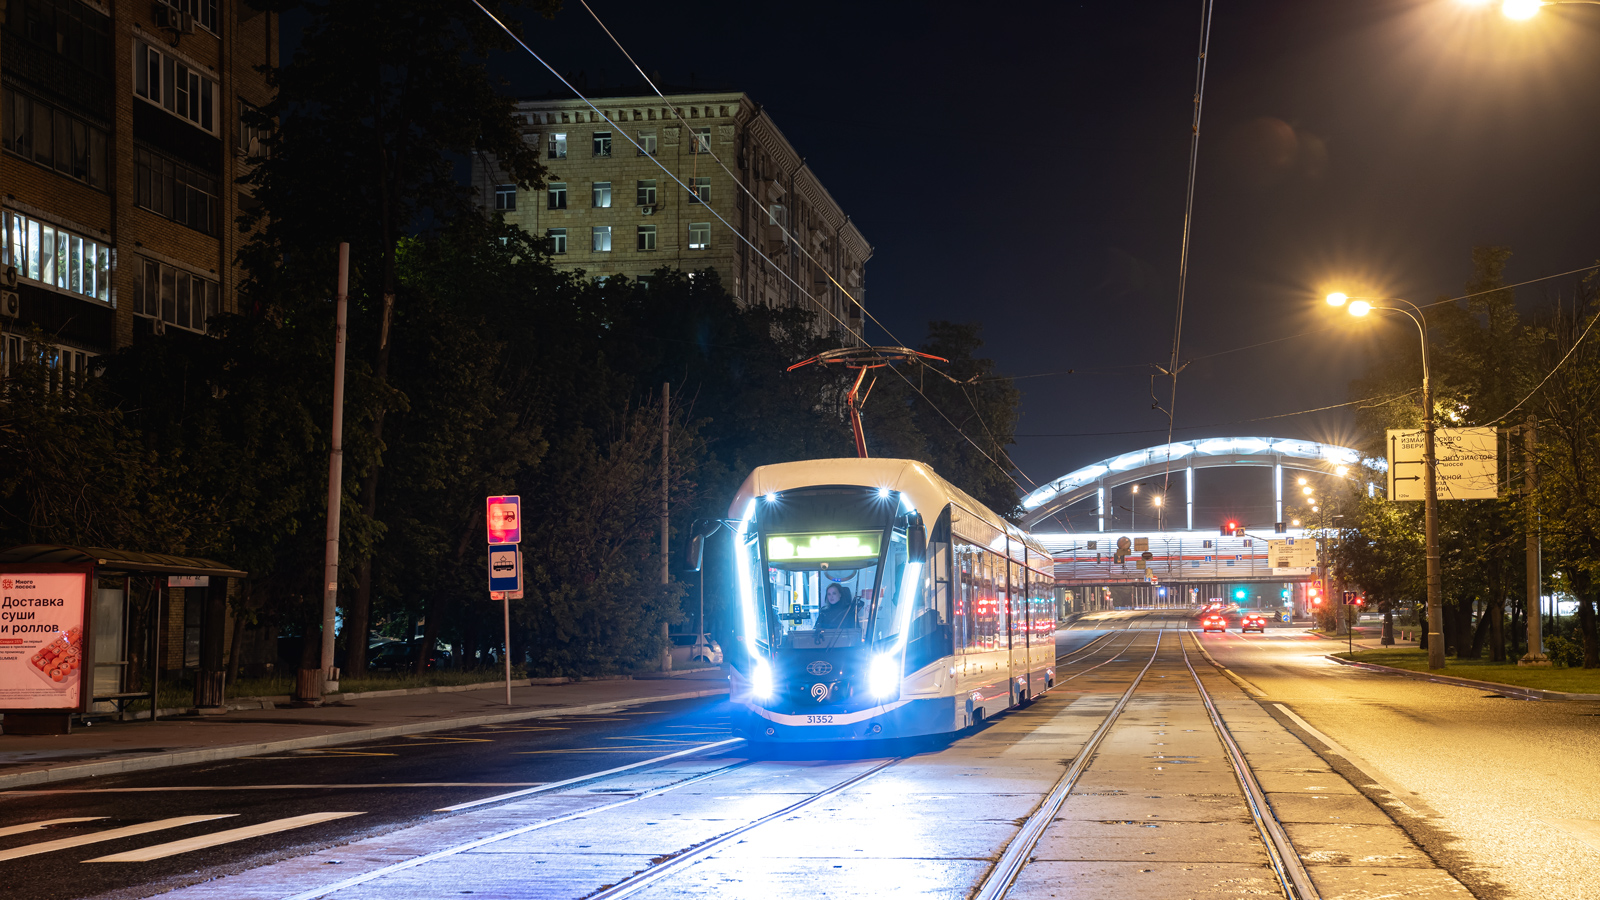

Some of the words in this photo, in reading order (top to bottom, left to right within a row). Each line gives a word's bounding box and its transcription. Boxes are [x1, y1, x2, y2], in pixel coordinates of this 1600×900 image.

[2, 597, 64, 608] Доставка
[1, 612, 35, 622] суши
[12, 625, 59, 635] роллов
[807, 715, 833, 723] 31352
